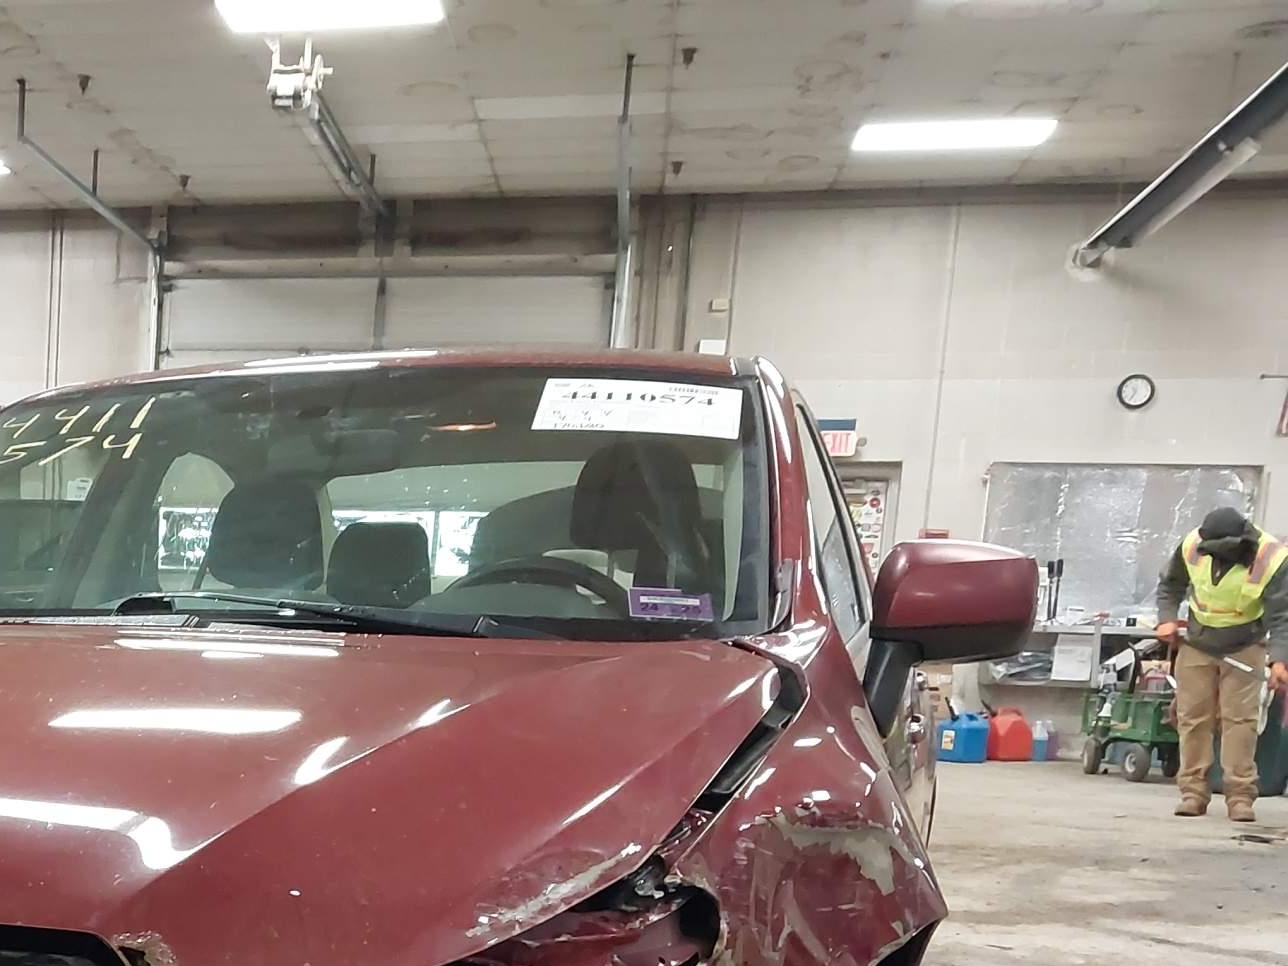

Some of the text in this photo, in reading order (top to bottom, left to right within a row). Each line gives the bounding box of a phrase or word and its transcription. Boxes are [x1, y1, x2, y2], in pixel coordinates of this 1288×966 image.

[561, 390, 715, 407] 44110574
[1, 396, 157, 439] 4411
[822, 432, 853, 454] EXIT
